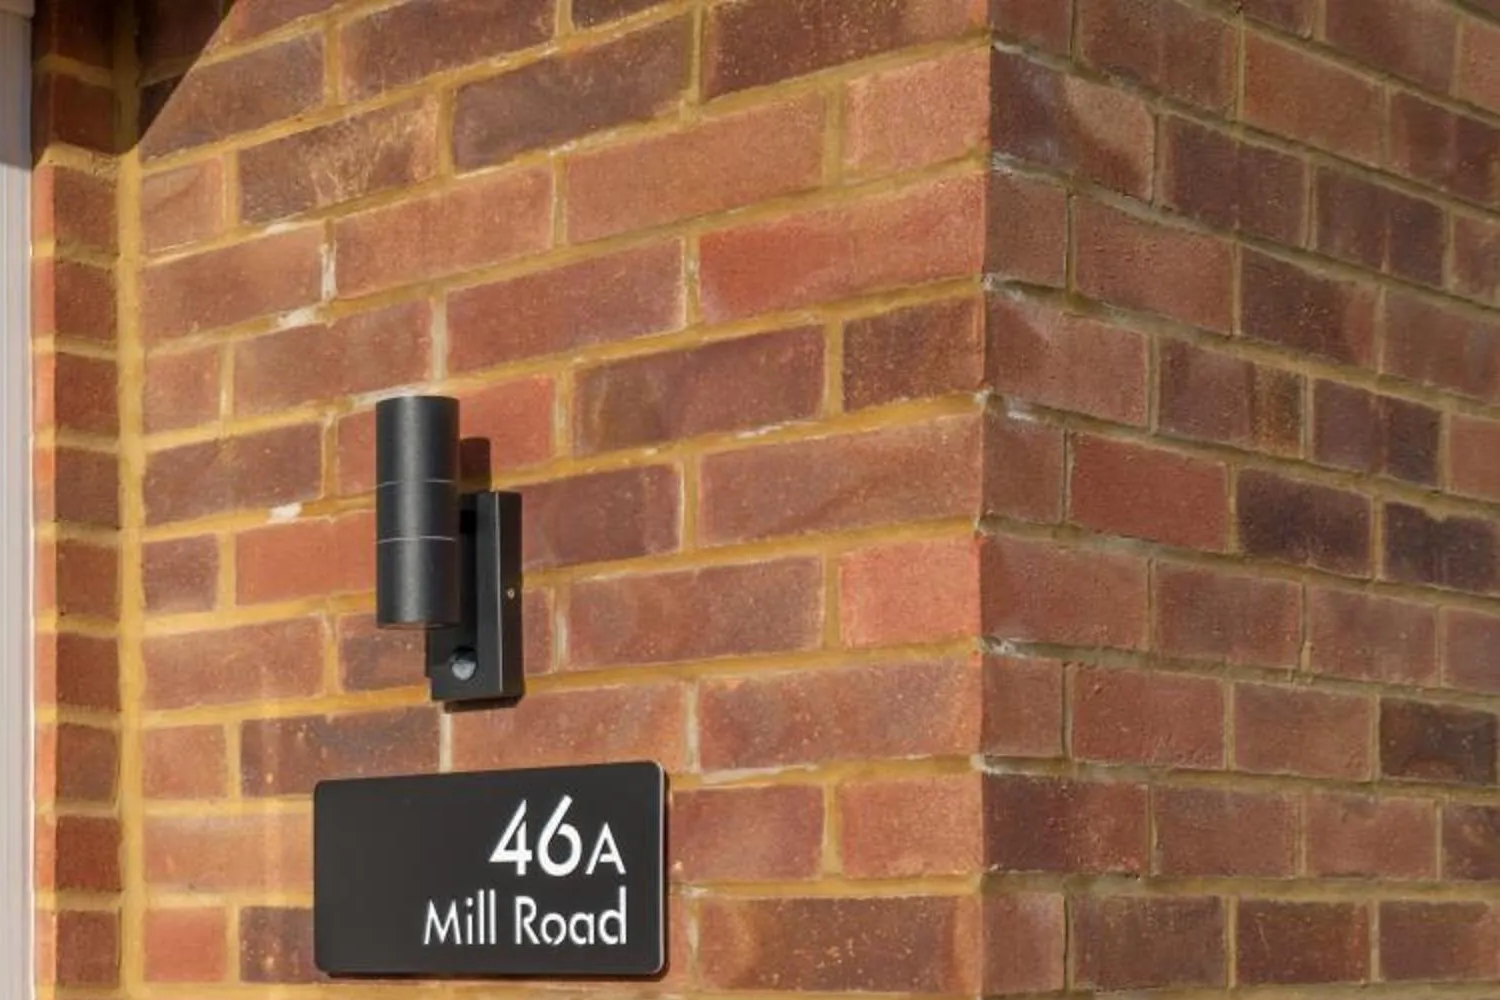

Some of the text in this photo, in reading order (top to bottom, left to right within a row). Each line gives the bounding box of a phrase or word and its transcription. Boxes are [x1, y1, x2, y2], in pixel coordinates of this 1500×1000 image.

[488, 795, 627, 877] 46A
[422, 885, 627, 946] Mill Road
